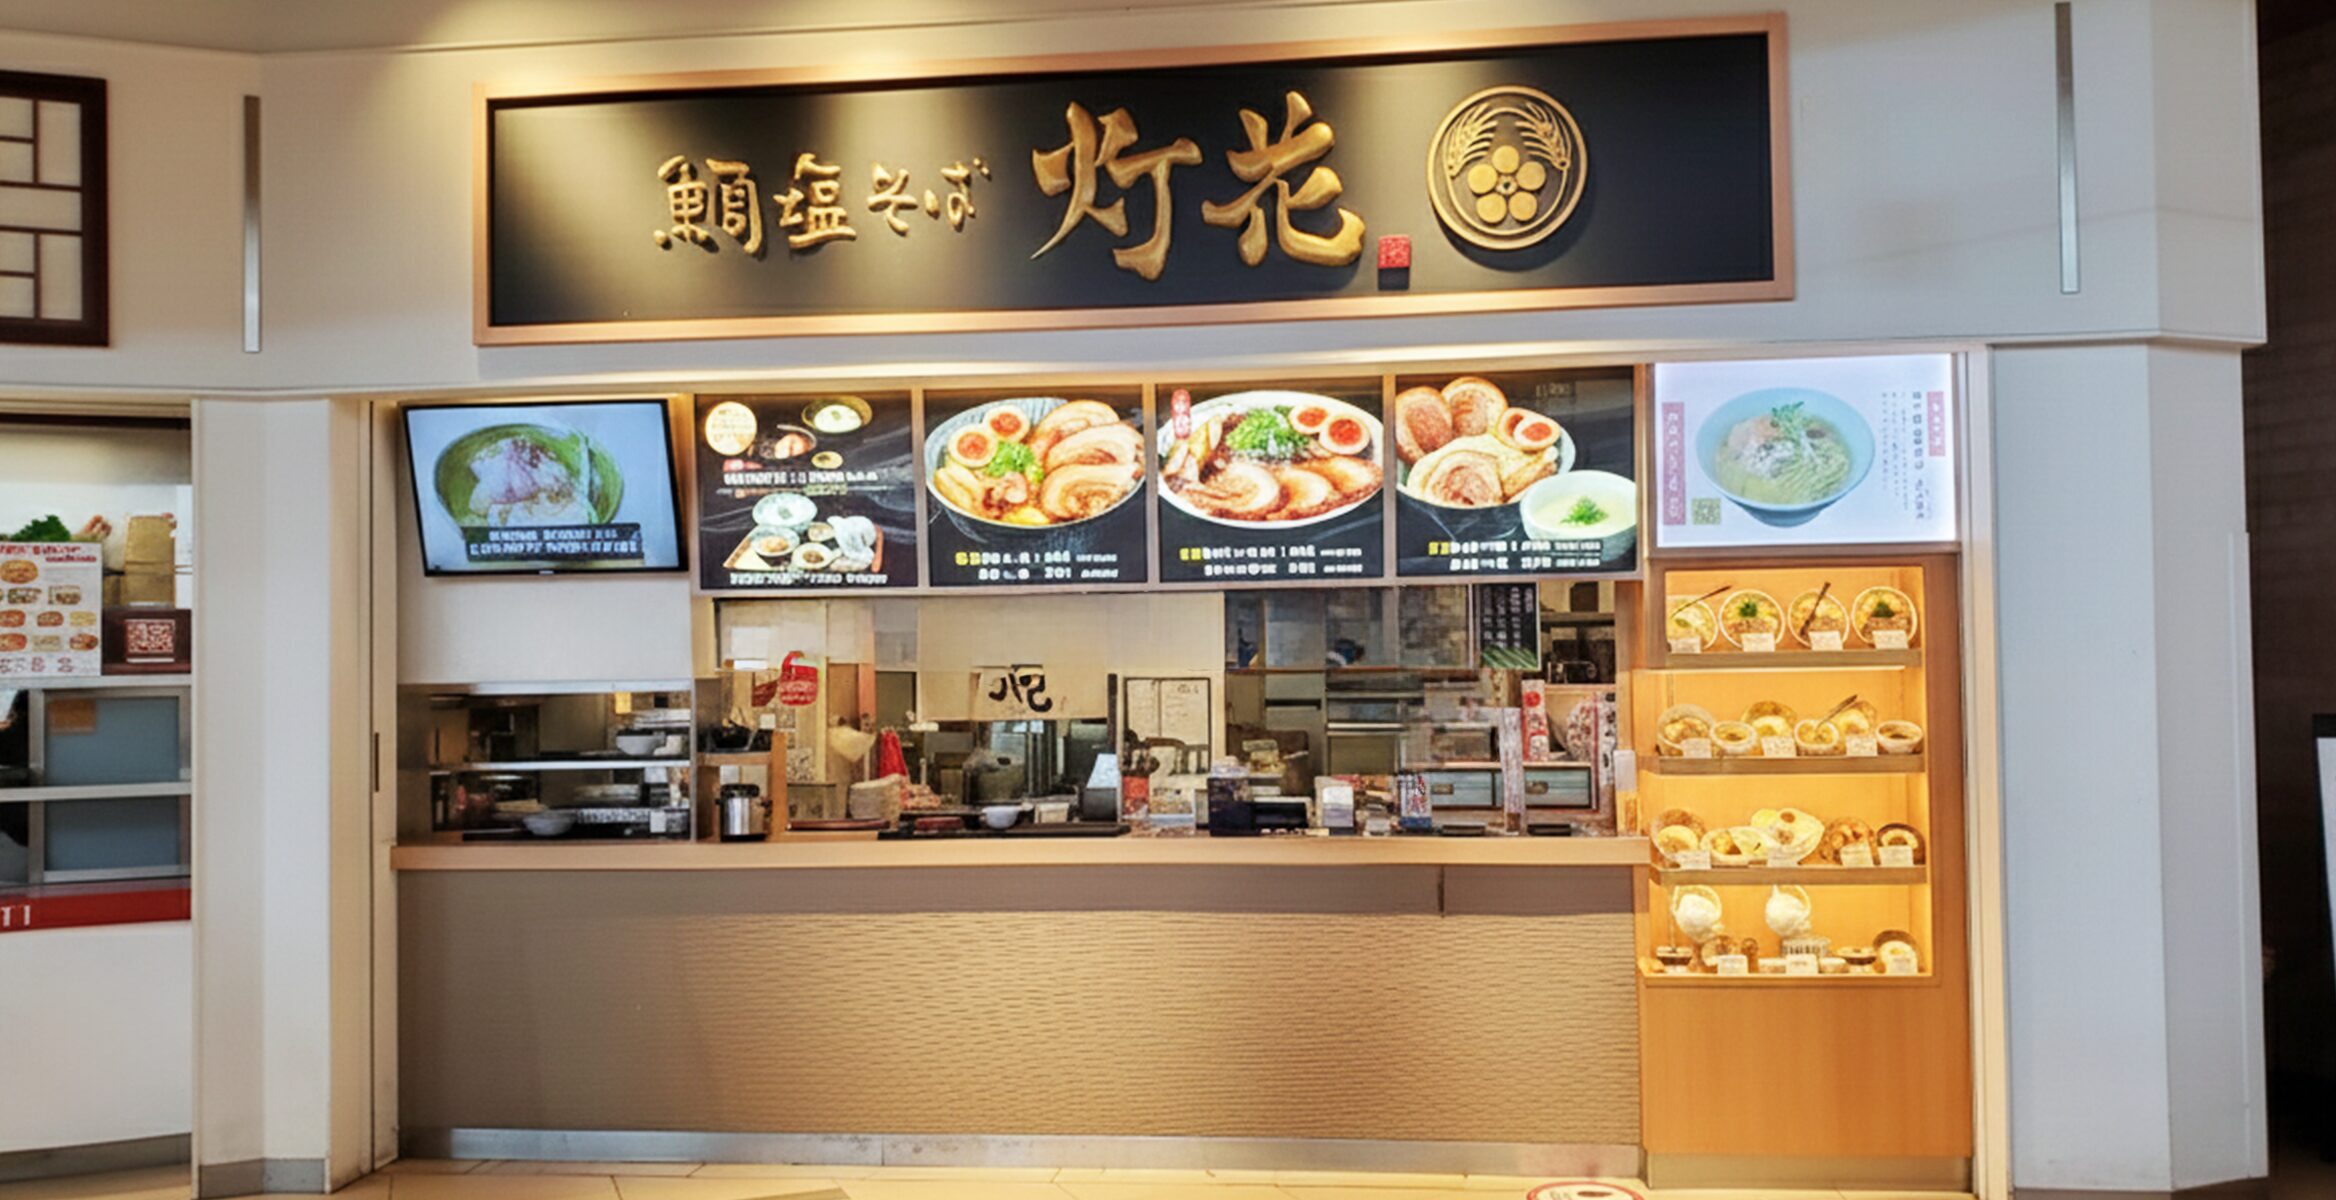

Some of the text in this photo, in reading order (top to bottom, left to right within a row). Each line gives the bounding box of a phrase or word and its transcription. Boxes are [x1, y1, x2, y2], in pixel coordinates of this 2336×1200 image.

[653, 91, 1365, 281] 鯛塩そば 灯花
